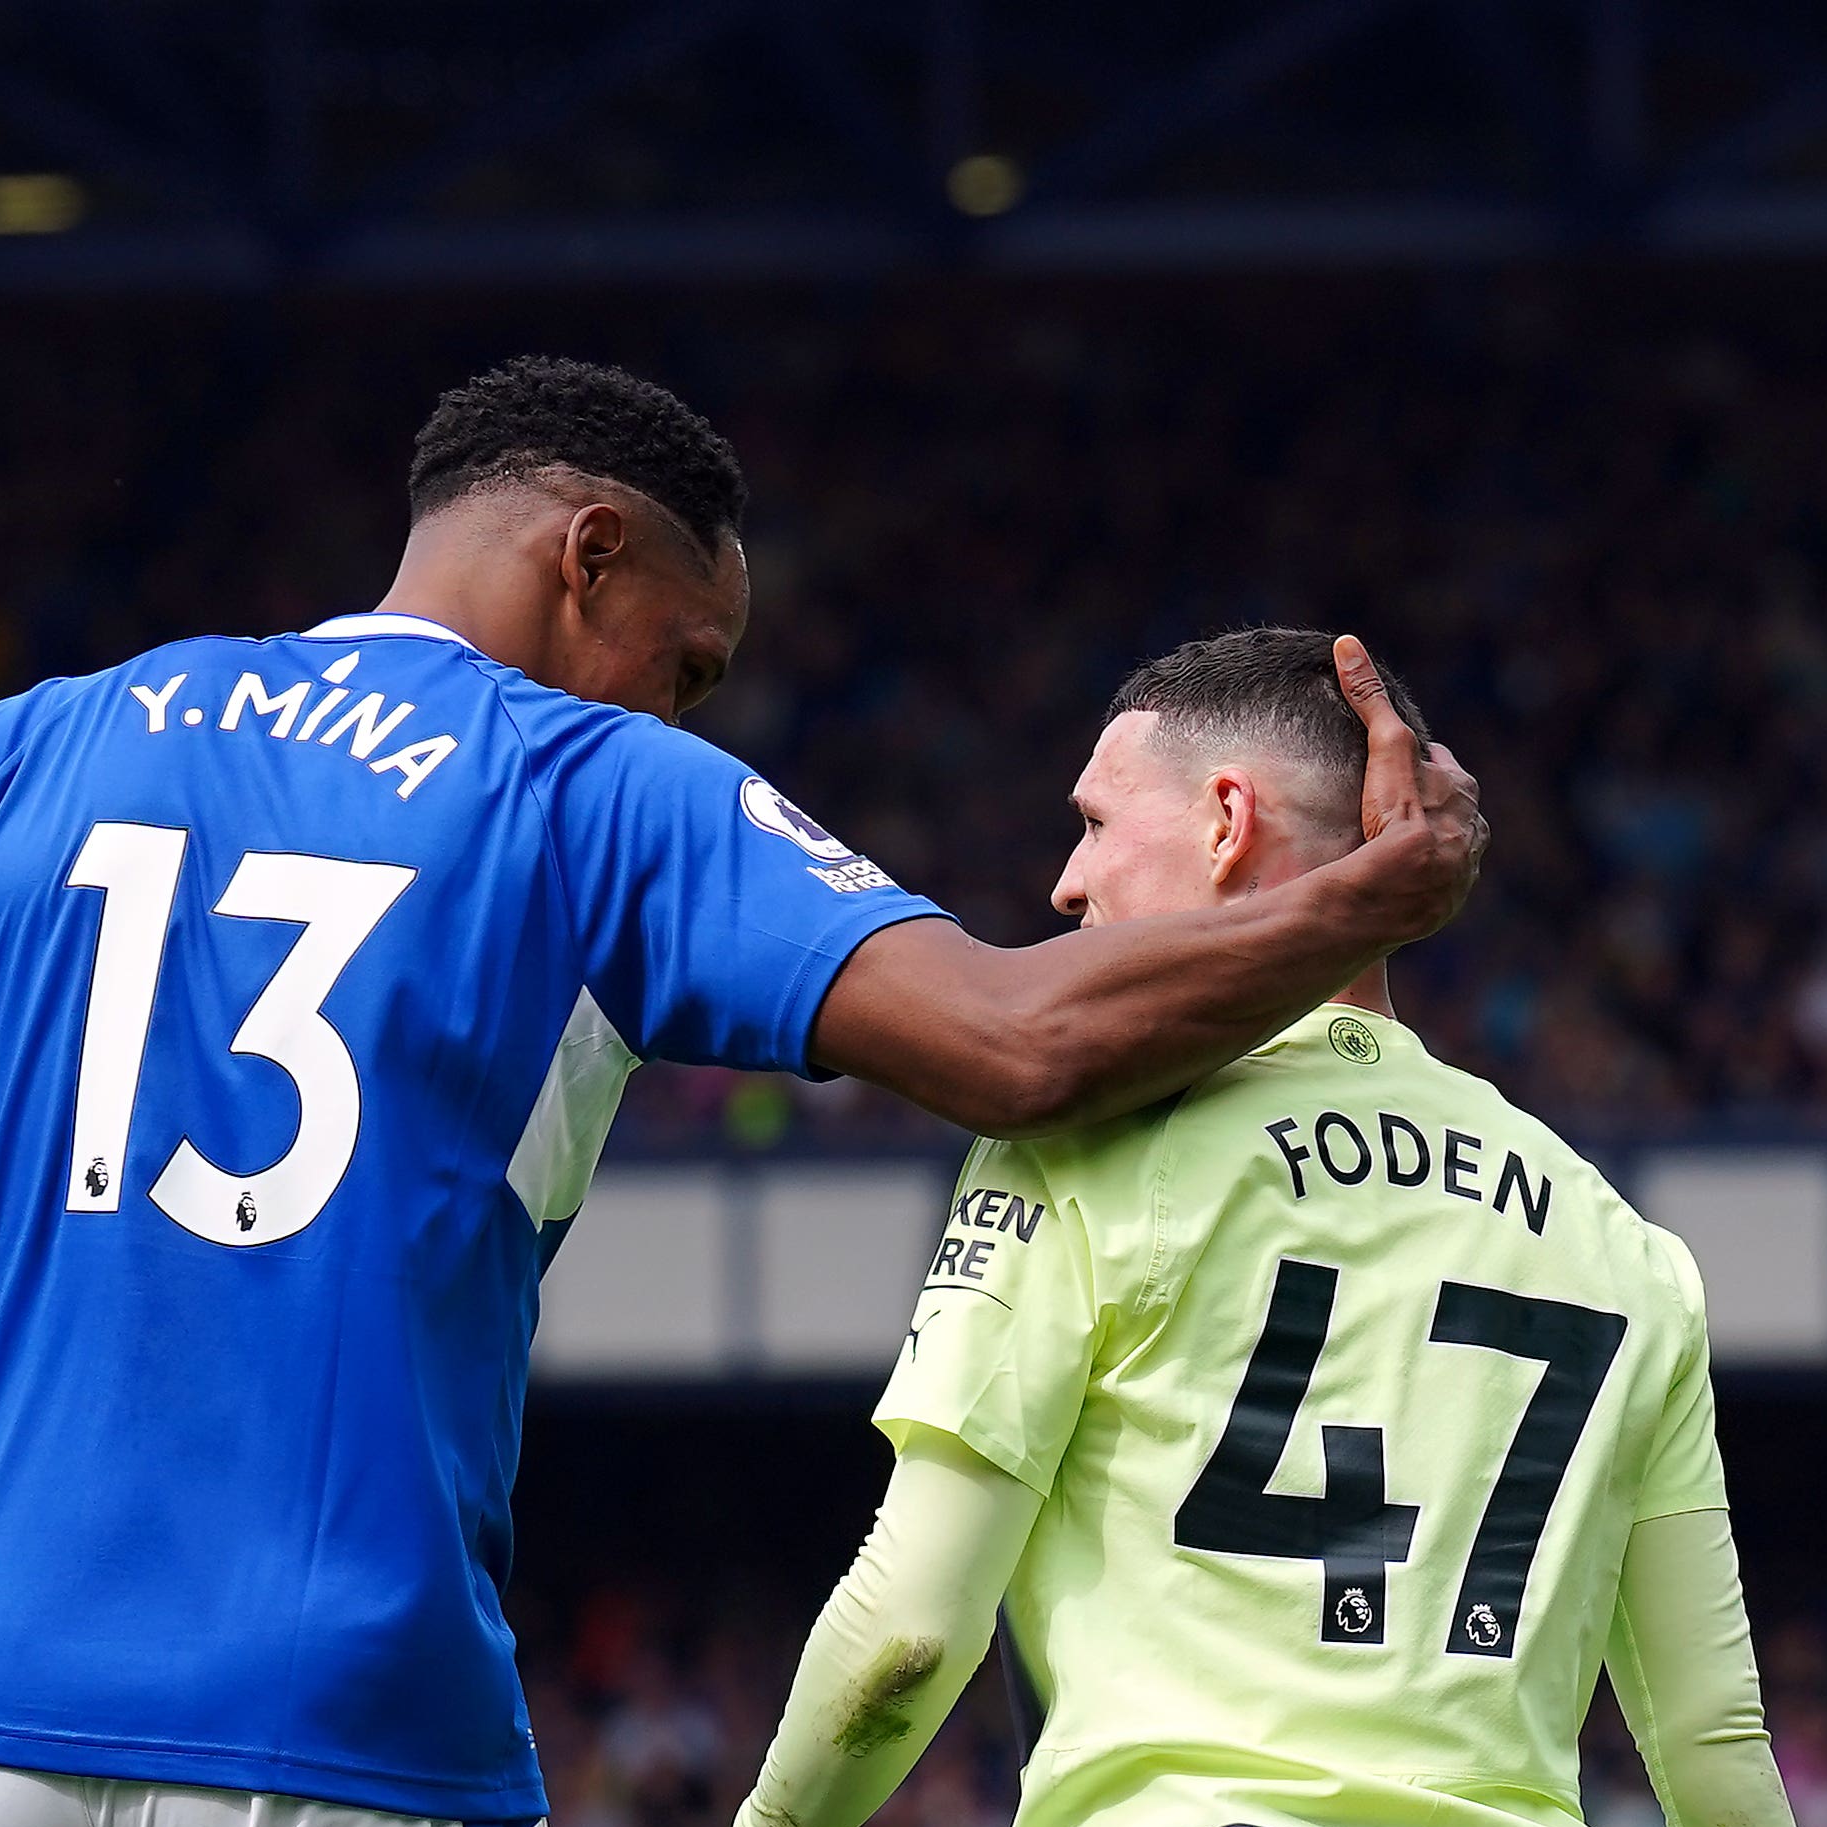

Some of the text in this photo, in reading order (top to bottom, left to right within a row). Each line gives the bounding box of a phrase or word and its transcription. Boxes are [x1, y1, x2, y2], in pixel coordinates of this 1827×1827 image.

[65, 821, 417, 1248] 13
[931, 1238, 995, 1280] RE
[1266, 1111, 1553, 1237] FODEN
[1174, 1257, 1628, 1658] 47
